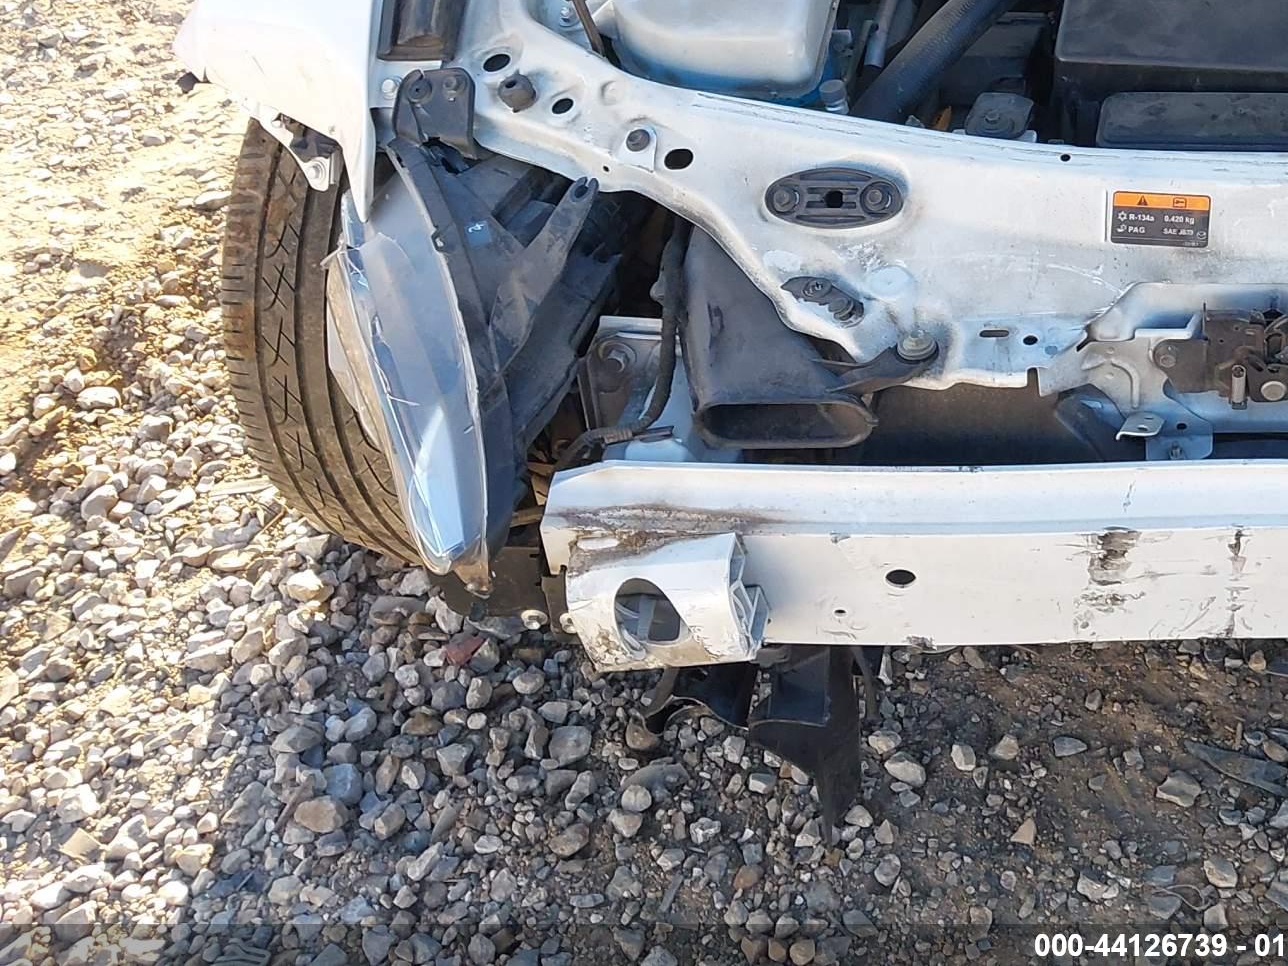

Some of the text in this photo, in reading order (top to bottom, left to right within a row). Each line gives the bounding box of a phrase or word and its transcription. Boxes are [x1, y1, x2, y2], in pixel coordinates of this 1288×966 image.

[1129, 213, 1155, 222] R-134a
[1186, 216, 1195, 225] kg
[1128, 226, 1145, 234] PAG
[1163, 227, 1177, 235] SAE
